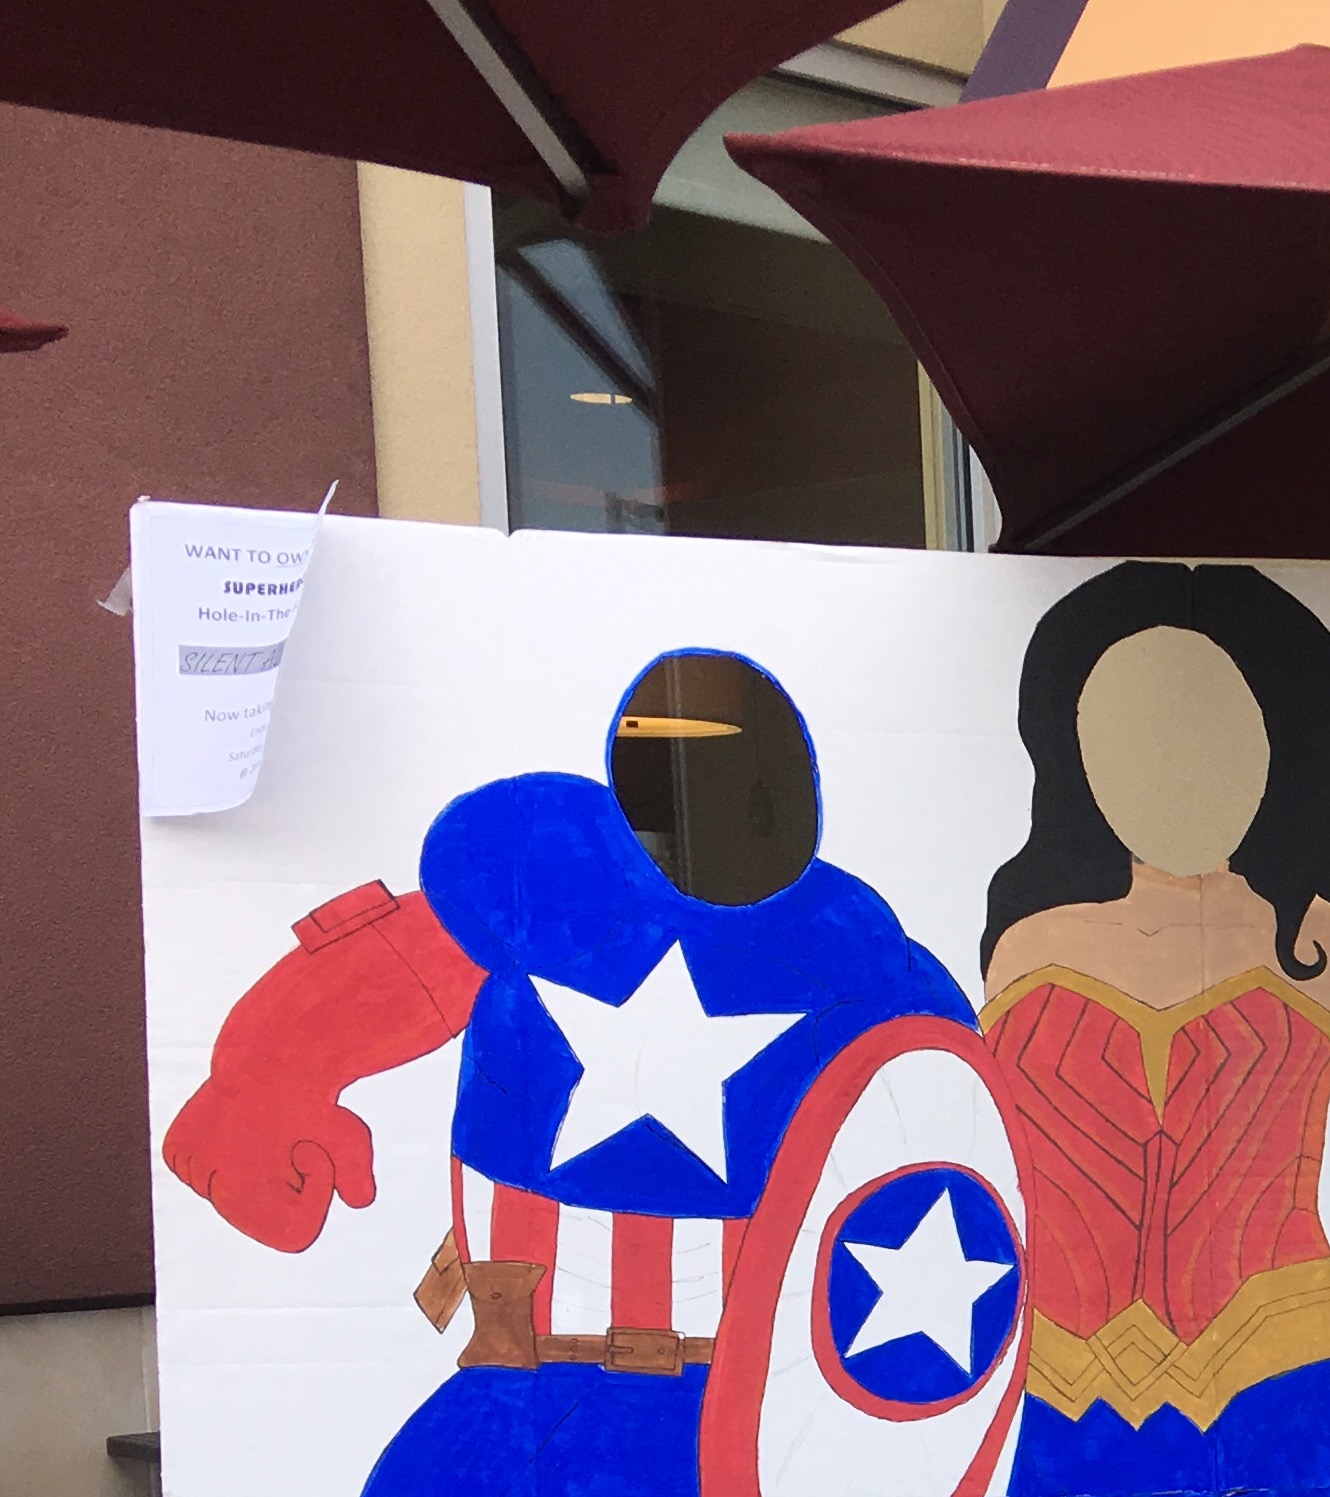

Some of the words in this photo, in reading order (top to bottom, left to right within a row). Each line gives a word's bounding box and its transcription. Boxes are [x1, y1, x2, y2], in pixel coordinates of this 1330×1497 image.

[185, 543, 242, 562] WANT
[247, 549, 271, 564] TO
[180, 650, 263, 674] SILENT
[205, 709, 240, 722] Now
